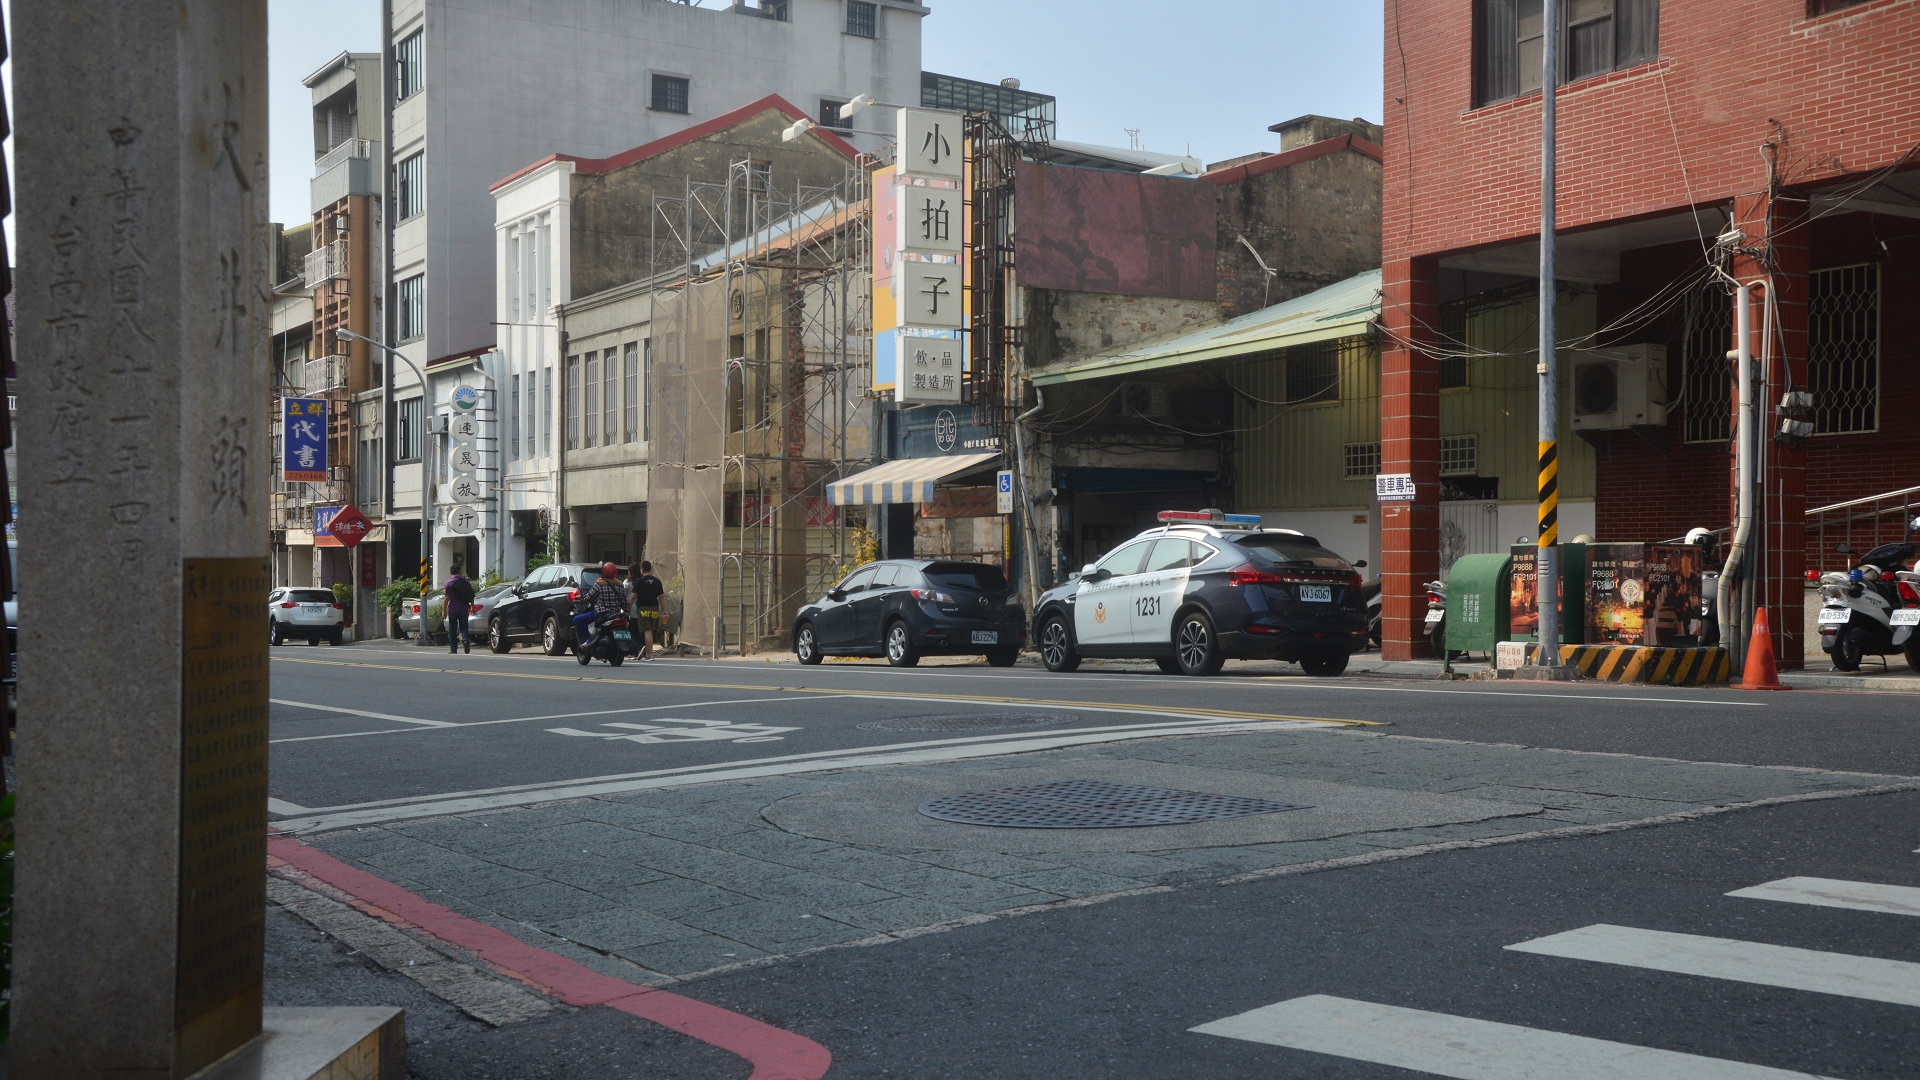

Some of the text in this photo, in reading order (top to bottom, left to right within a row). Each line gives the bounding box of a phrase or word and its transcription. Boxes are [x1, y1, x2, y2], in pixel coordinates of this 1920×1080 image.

[919, 122, 951, 316] 小拍子
[913, 373, 955, 390] 製造所
[288, 402, 324, 417] 立群
[291, 420, 320, 468] 代書
[1377, 477, 1414, 493] 警車專用
[1513, 563, 1533, 571] P9688
[1649, 573, 1670, 582] FC2101
[1301, 588, 1330, 600] AVJ-6067
[1135, 595, 1161, 616] 1231
